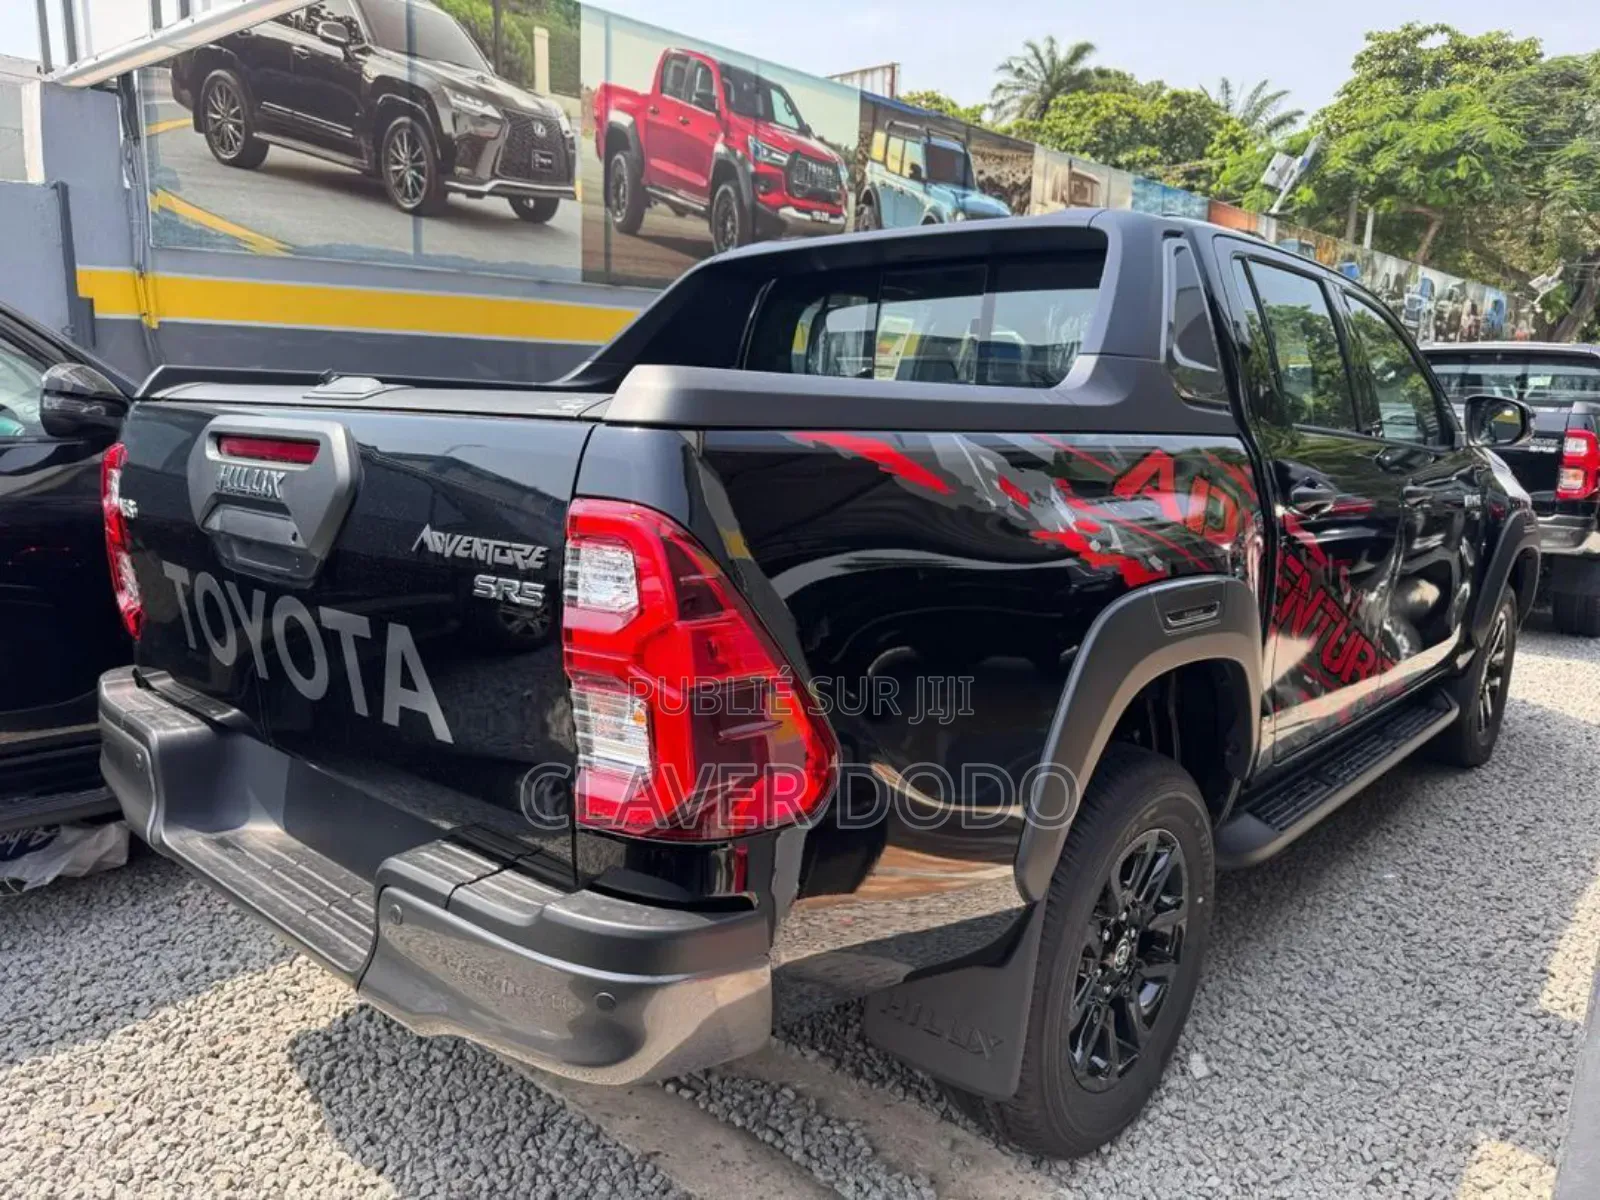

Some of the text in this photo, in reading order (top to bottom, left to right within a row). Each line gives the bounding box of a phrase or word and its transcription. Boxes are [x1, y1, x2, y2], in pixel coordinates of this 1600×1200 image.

[217, 464, 286, 500] HILUX
[411, 523, 549, 570] ADVENTURE
[163, 560, 454, 745] TOYOTA
